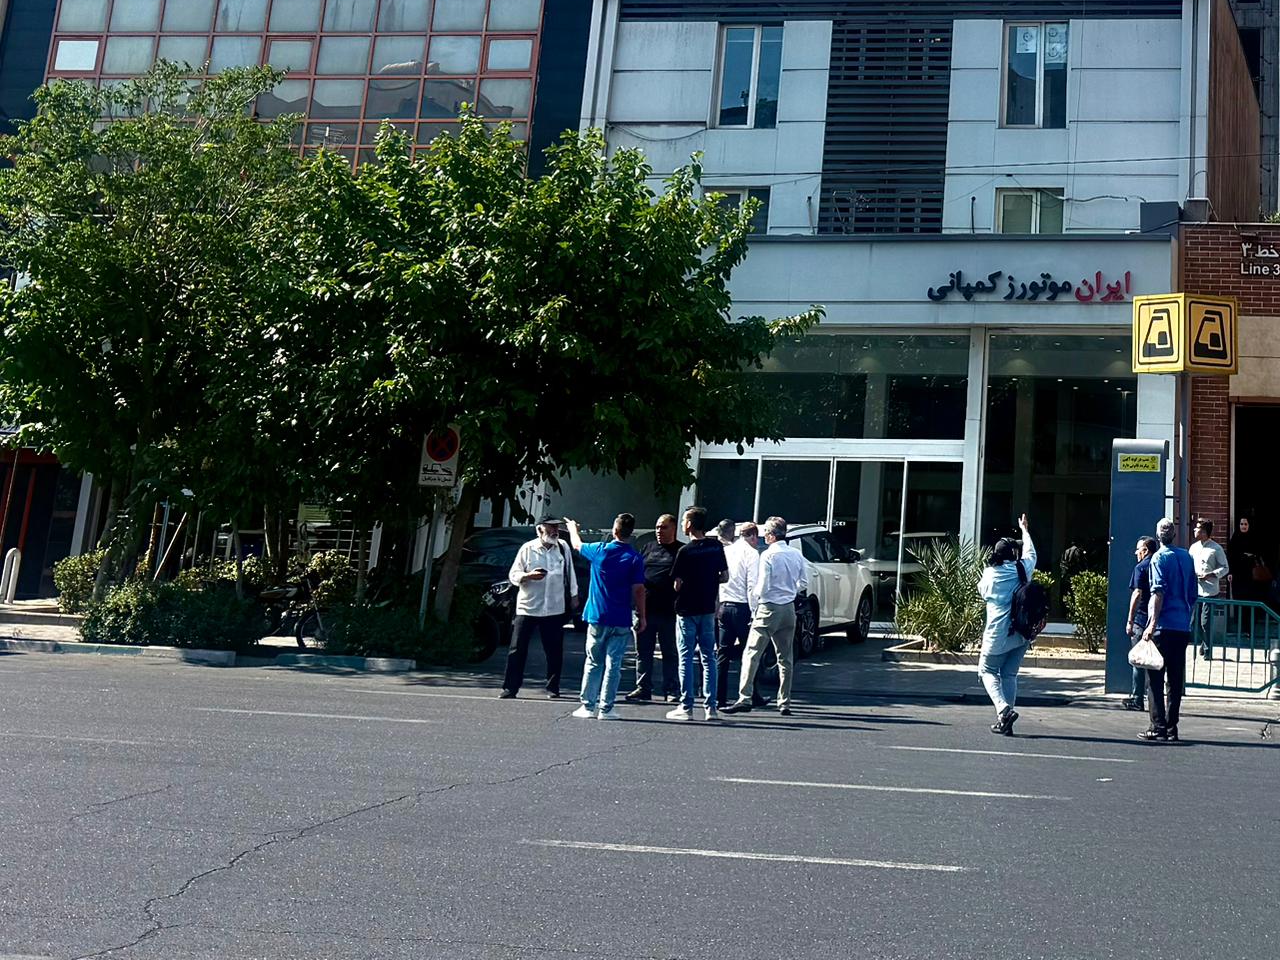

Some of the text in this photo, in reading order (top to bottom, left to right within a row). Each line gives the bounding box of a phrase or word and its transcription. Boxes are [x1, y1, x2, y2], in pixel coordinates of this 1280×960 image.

[1254, 243, 1280, 258] خط
[1240, 262, 1280, 276] Line 3
[926, 270, 1132, 303] ایران موتورز کمپانی
